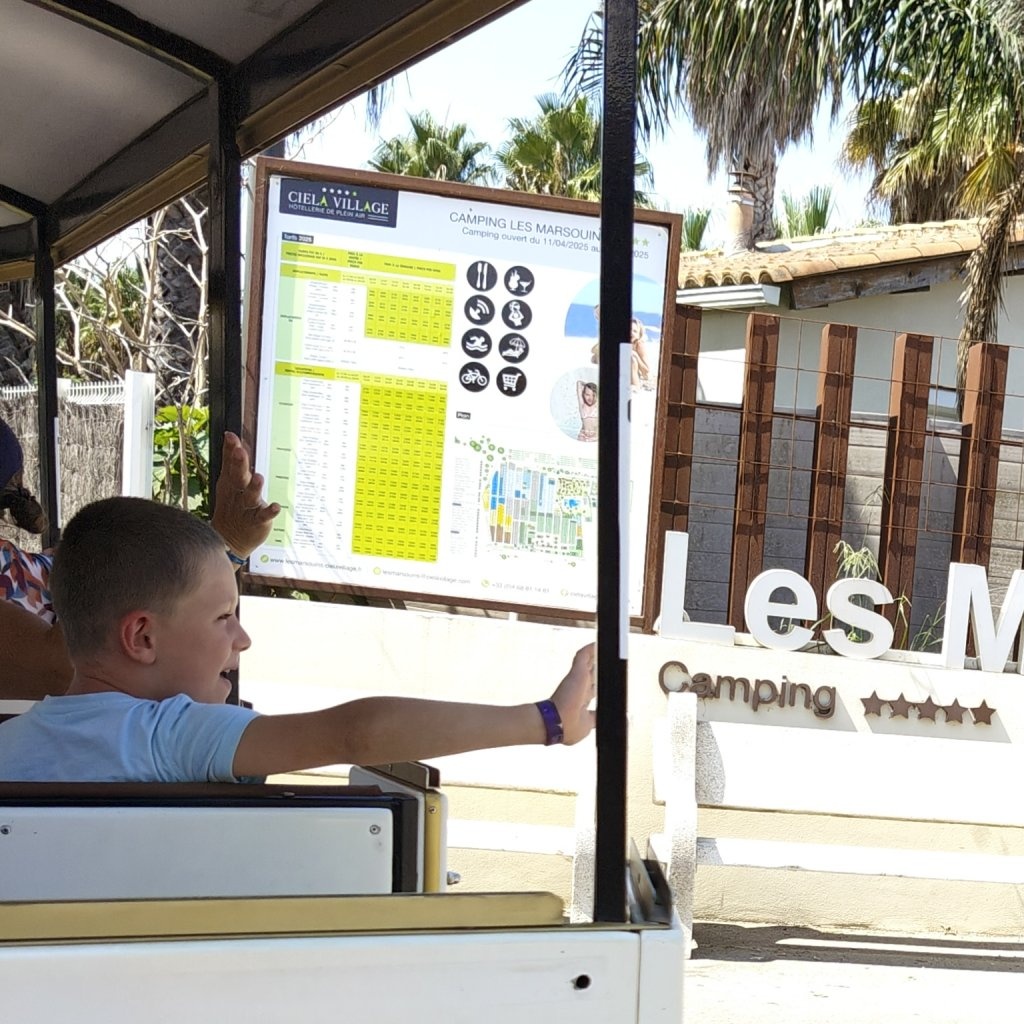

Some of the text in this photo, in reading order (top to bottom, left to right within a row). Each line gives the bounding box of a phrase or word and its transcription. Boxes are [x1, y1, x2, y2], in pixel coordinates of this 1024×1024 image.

[288, 191, 389, 215] CIELA VILLAGE
[326, 208, 335, 216] DE
[336, 209, 354, 218] PLEIN
[355, 211, 365, 219] AIR
[449, 211, 600, 242] CAMPING LES MARSOUIN
[462, 227, 499, 241] Camping
[501, 233, 527, 243] ouvert
[530, 235, 540, 245] du
[544, 237, 589, 252] 11/04/2025
[632, 249, 649, 260] 025
[660, 530, 895, 659] Les
[658, 660, 837, 719] Camping
